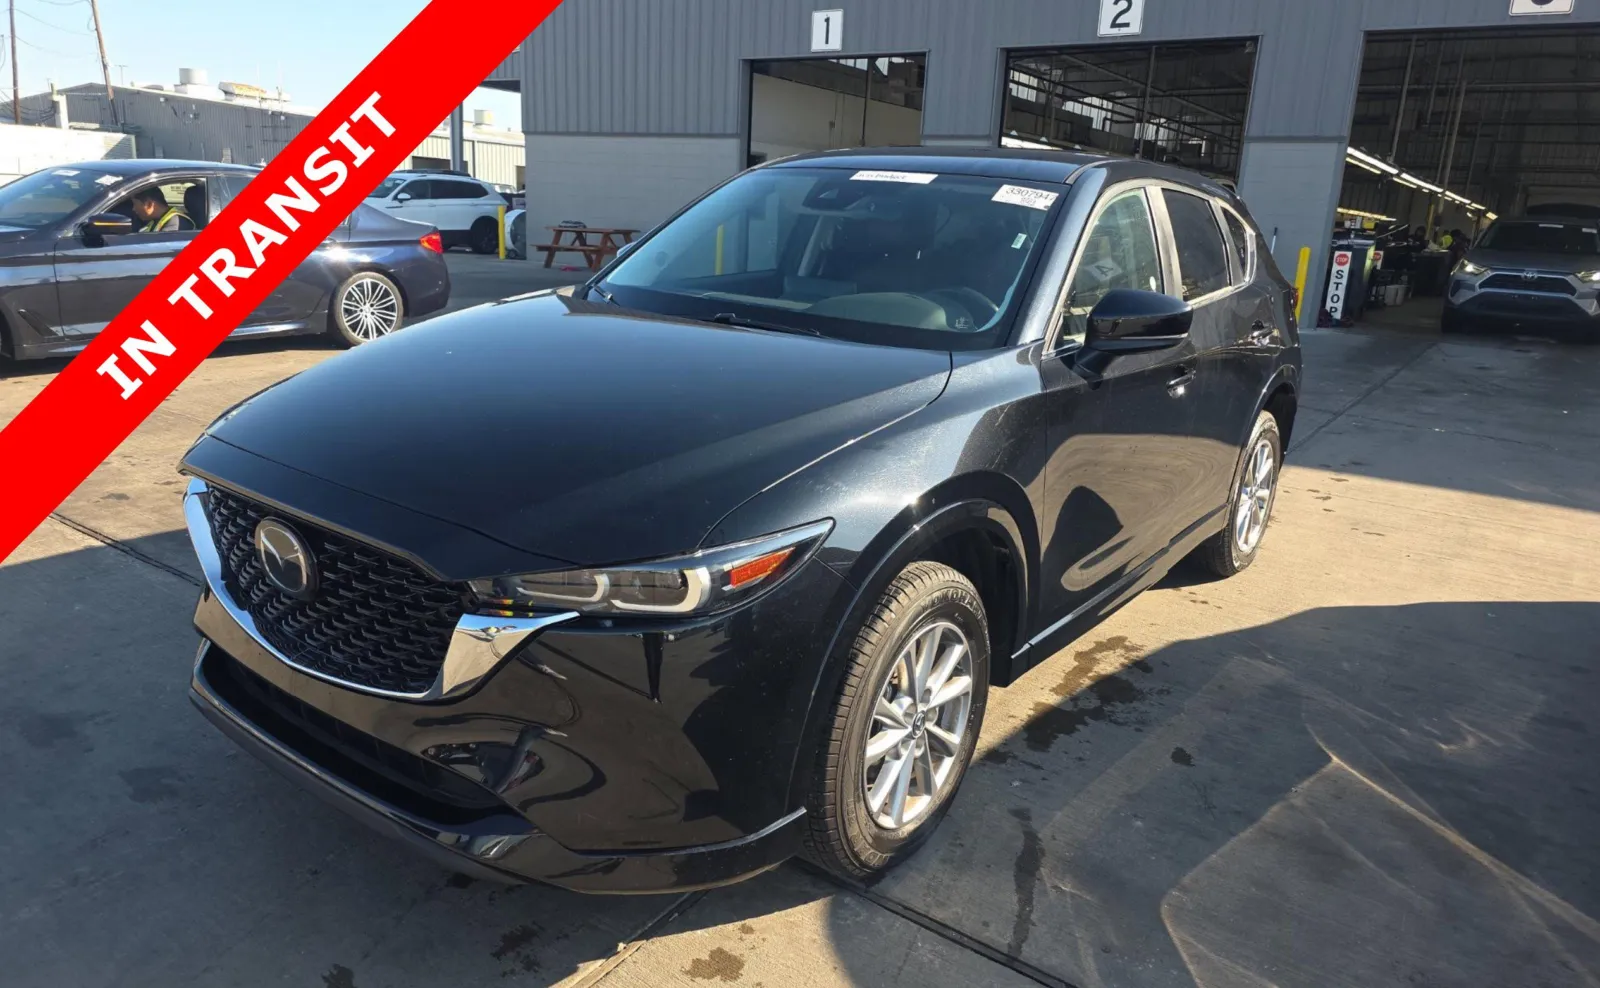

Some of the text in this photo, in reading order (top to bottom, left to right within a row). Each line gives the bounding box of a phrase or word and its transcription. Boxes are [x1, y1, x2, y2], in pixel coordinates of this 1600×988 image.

[1109, 0, 1133, 29] 2
[823, 16, 831, 45] 1
[1328, 269, 1345, 317] STOP
